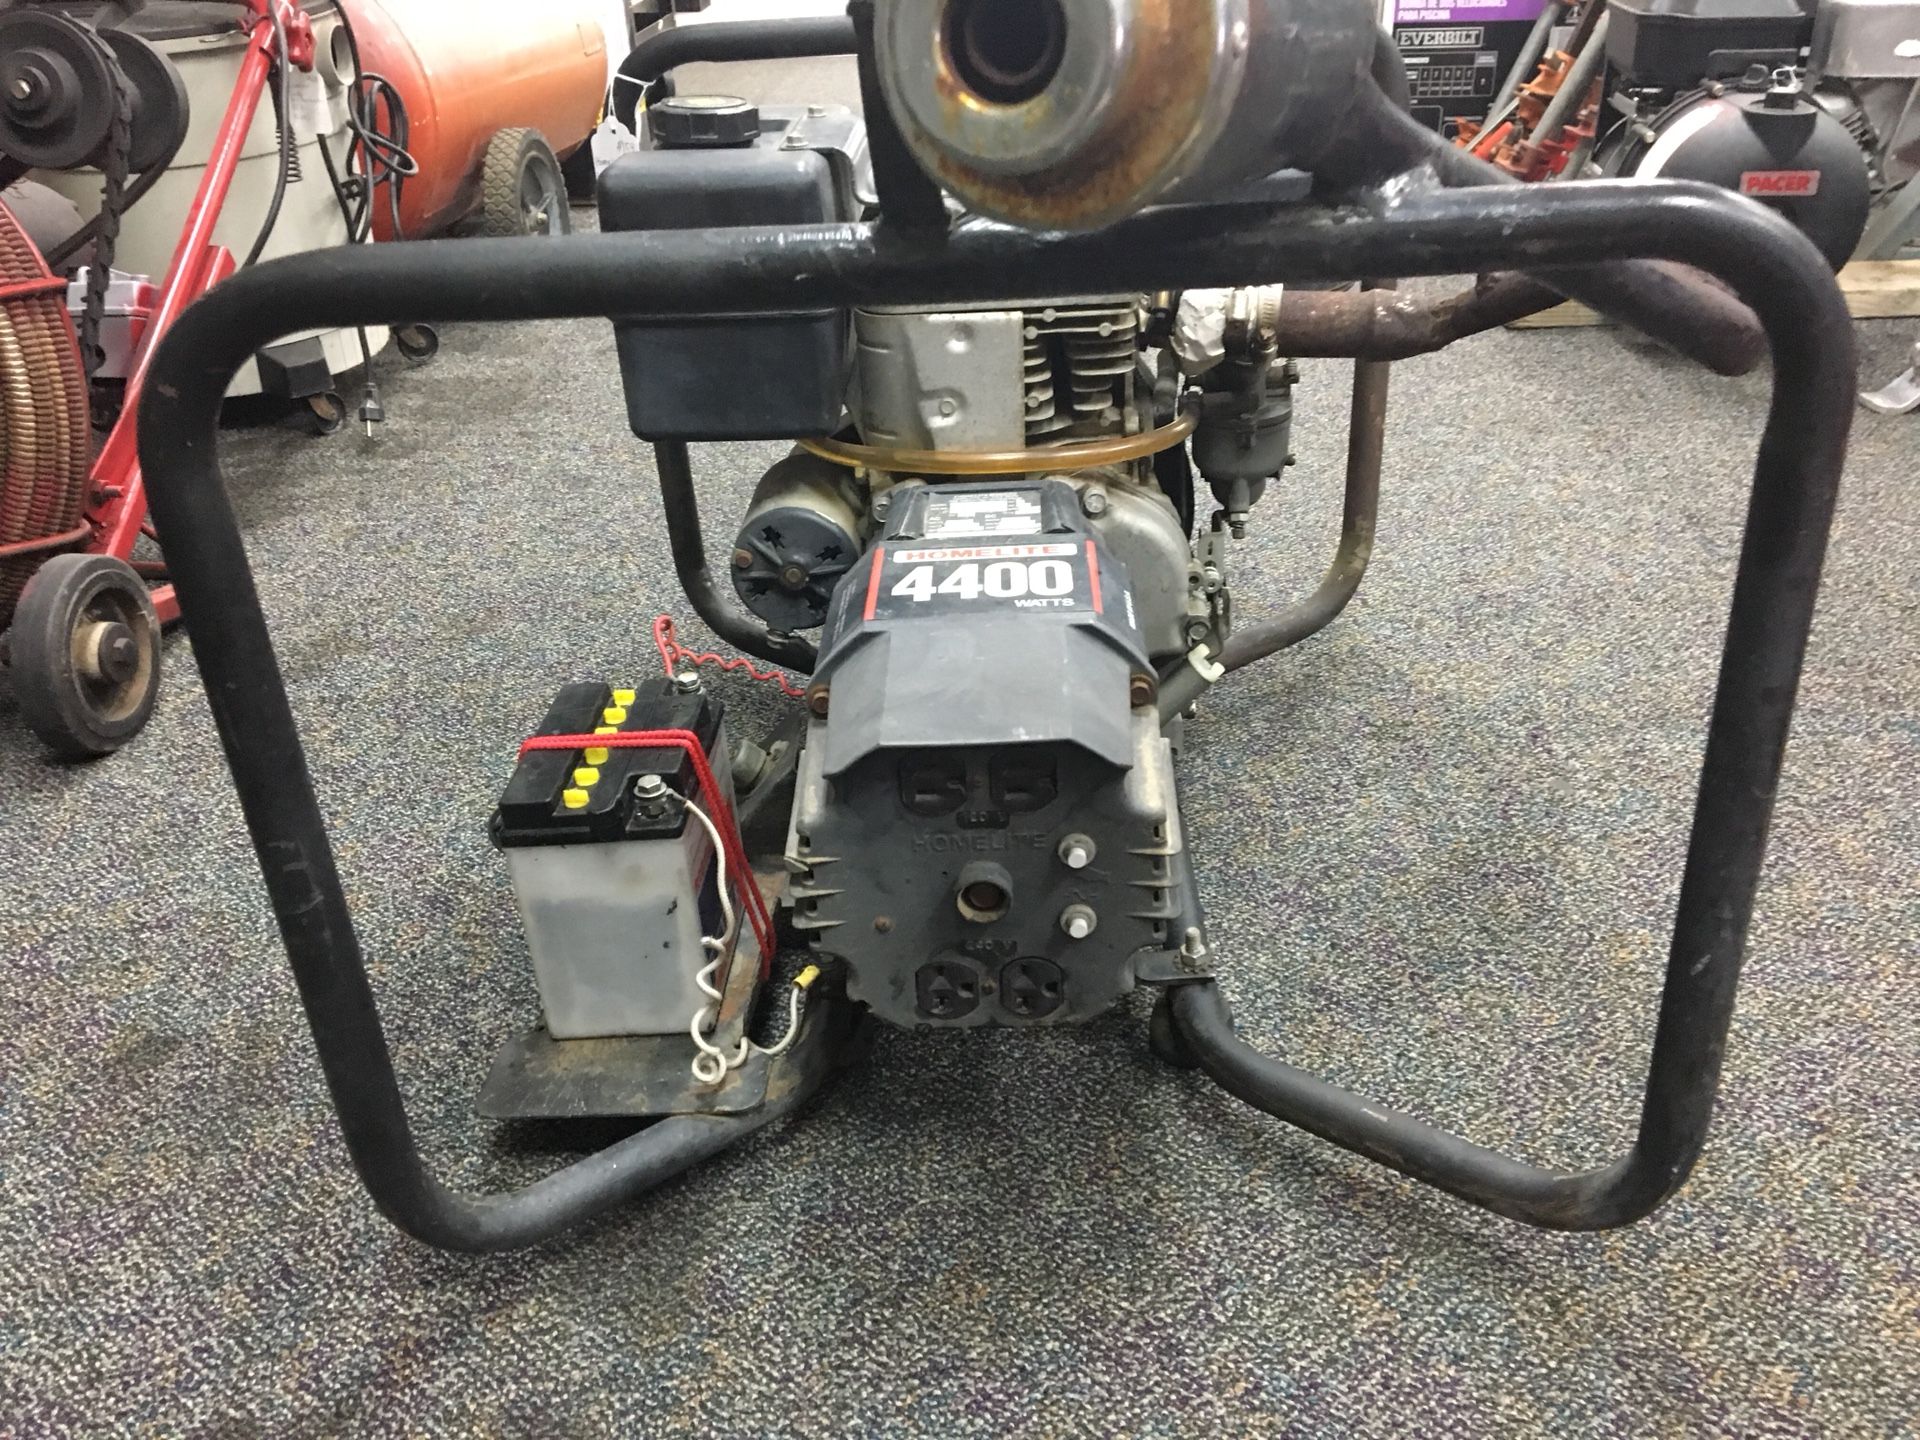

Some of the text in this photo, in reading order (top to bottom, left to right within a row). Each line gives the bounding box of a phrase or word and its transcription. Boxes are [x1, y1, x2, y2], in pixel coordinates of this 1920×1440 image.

[1400, 31, 1479, 45] EVERBILT
[1745, 175, 1809, 192] PACER
[906, 546, 1060, 560] HOMELITE
[891, 560, 1074, 602] 4400
[1014, 598, 1075, 607] WATTS
[911, 833, 1048, 851] HOMELITE
